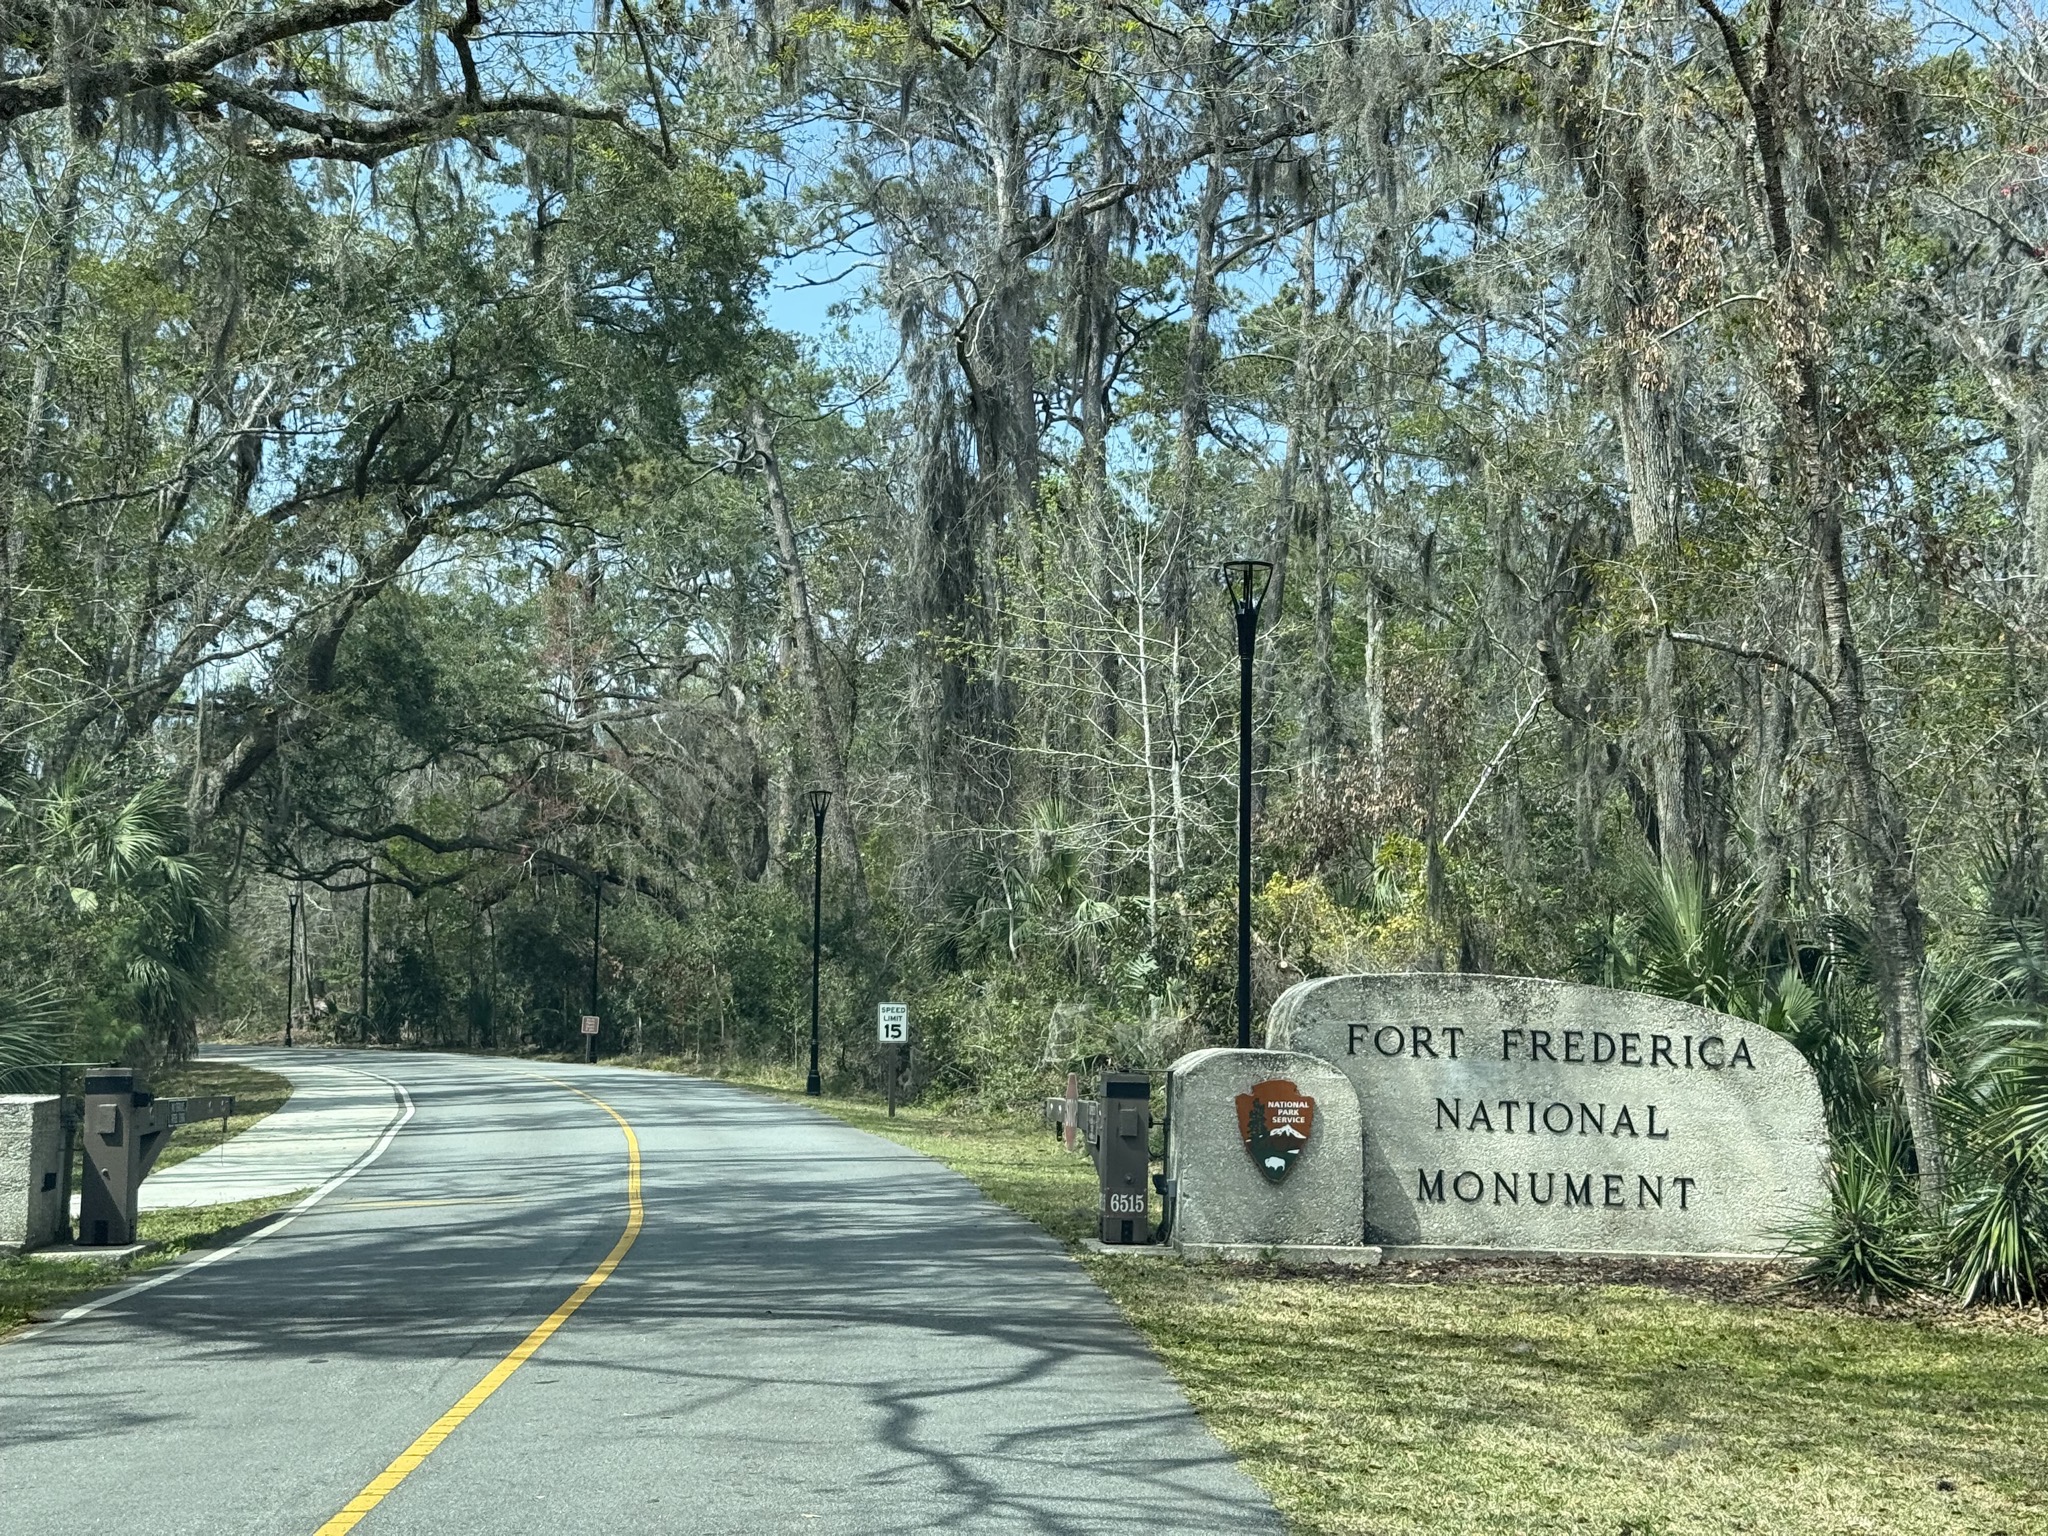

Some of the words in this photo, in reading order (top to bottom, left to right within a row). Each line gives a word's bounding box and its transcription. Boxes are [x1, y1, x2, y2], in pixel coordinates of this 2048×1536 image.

[881, 1006, 906, 1014] SPEED
[884, 1023, 902, 1039] 15
[1346, 1023, 1465, 1059] FORT
[1501, 1028, 1756, 1070] FREDERICA
[1267, 1101, 1310, 1109] NATIONAL
[1277, 1108, 1300, 1116] PARK
[1271, 1116, 1306, 1124] SERVICE
[1435, 1097, 1670, 1141] NATIONAL
[1416, 1168, 1697, 1211] MONUMENT
[1110, 1193, 1145, 1213] 6515
